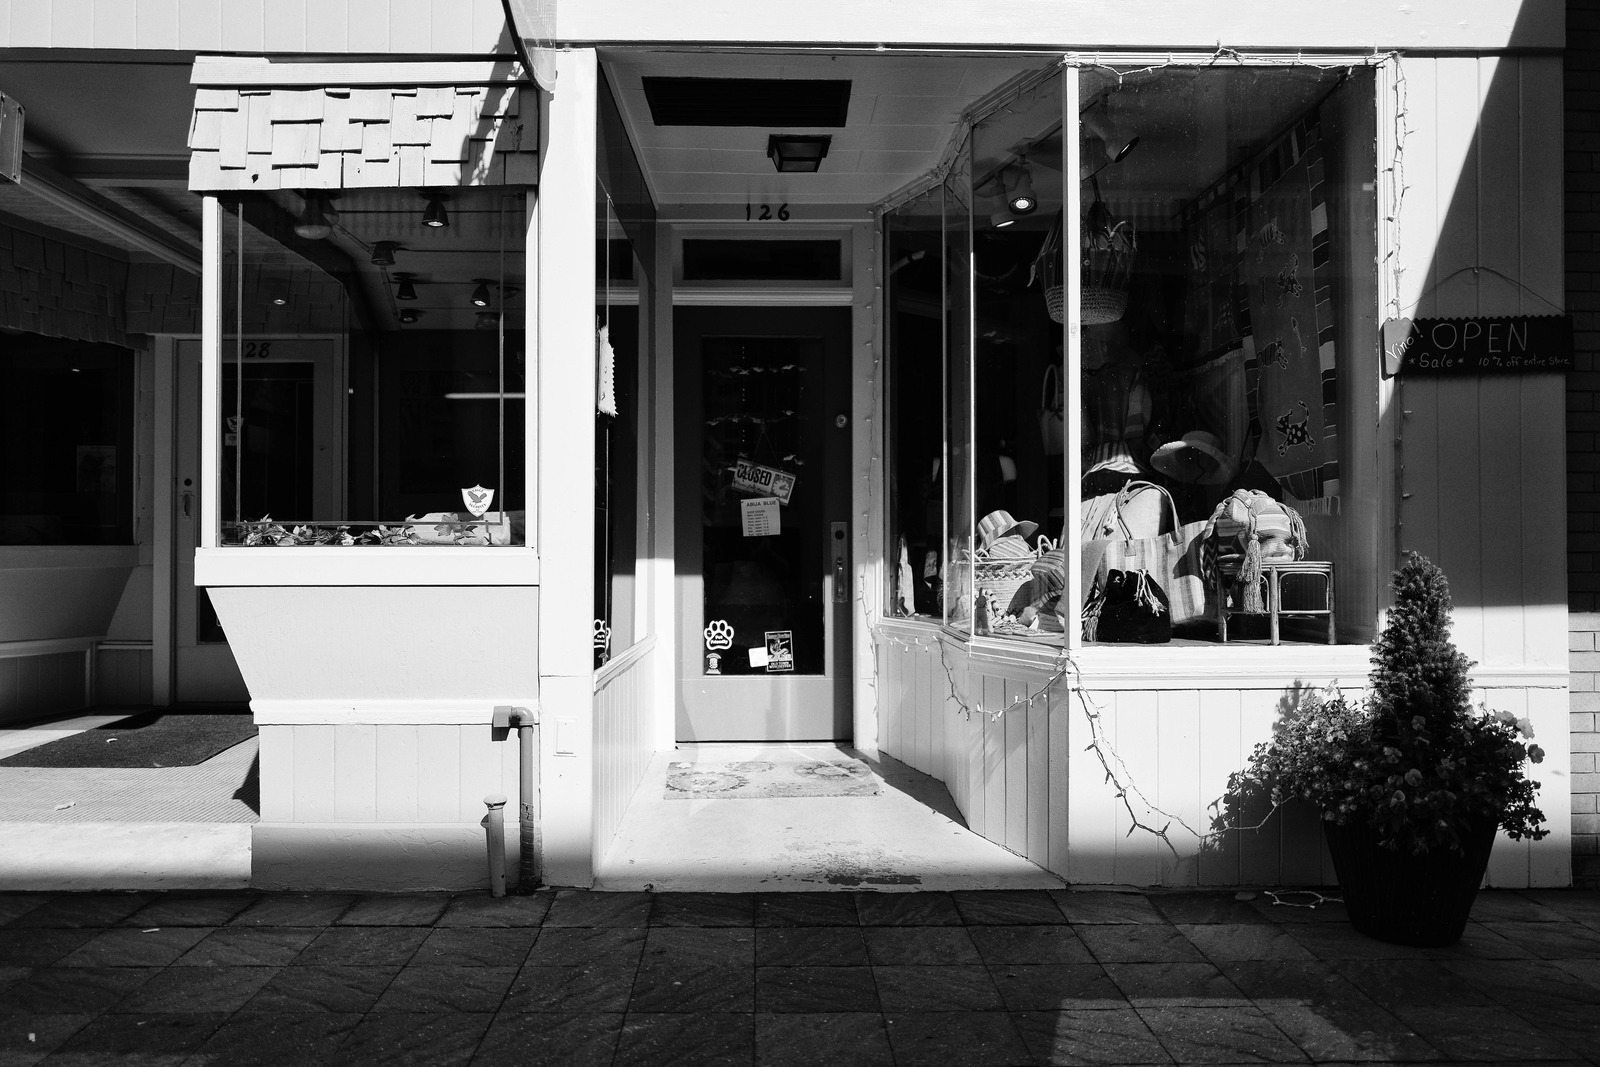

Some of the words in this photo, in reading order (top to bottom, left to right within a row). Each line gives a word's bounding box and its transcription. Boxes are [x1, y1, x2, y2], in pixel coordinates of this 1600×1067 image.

[746, 202, 790, 221] 126
[1431, 321, 1528, 353] OPEN
[239, 342, 272, 358] 28
[1506, 355, 1522, 368] off
[1523, 354, 1546, 366] entire
[736, 463, 773, 487] CLOSED
